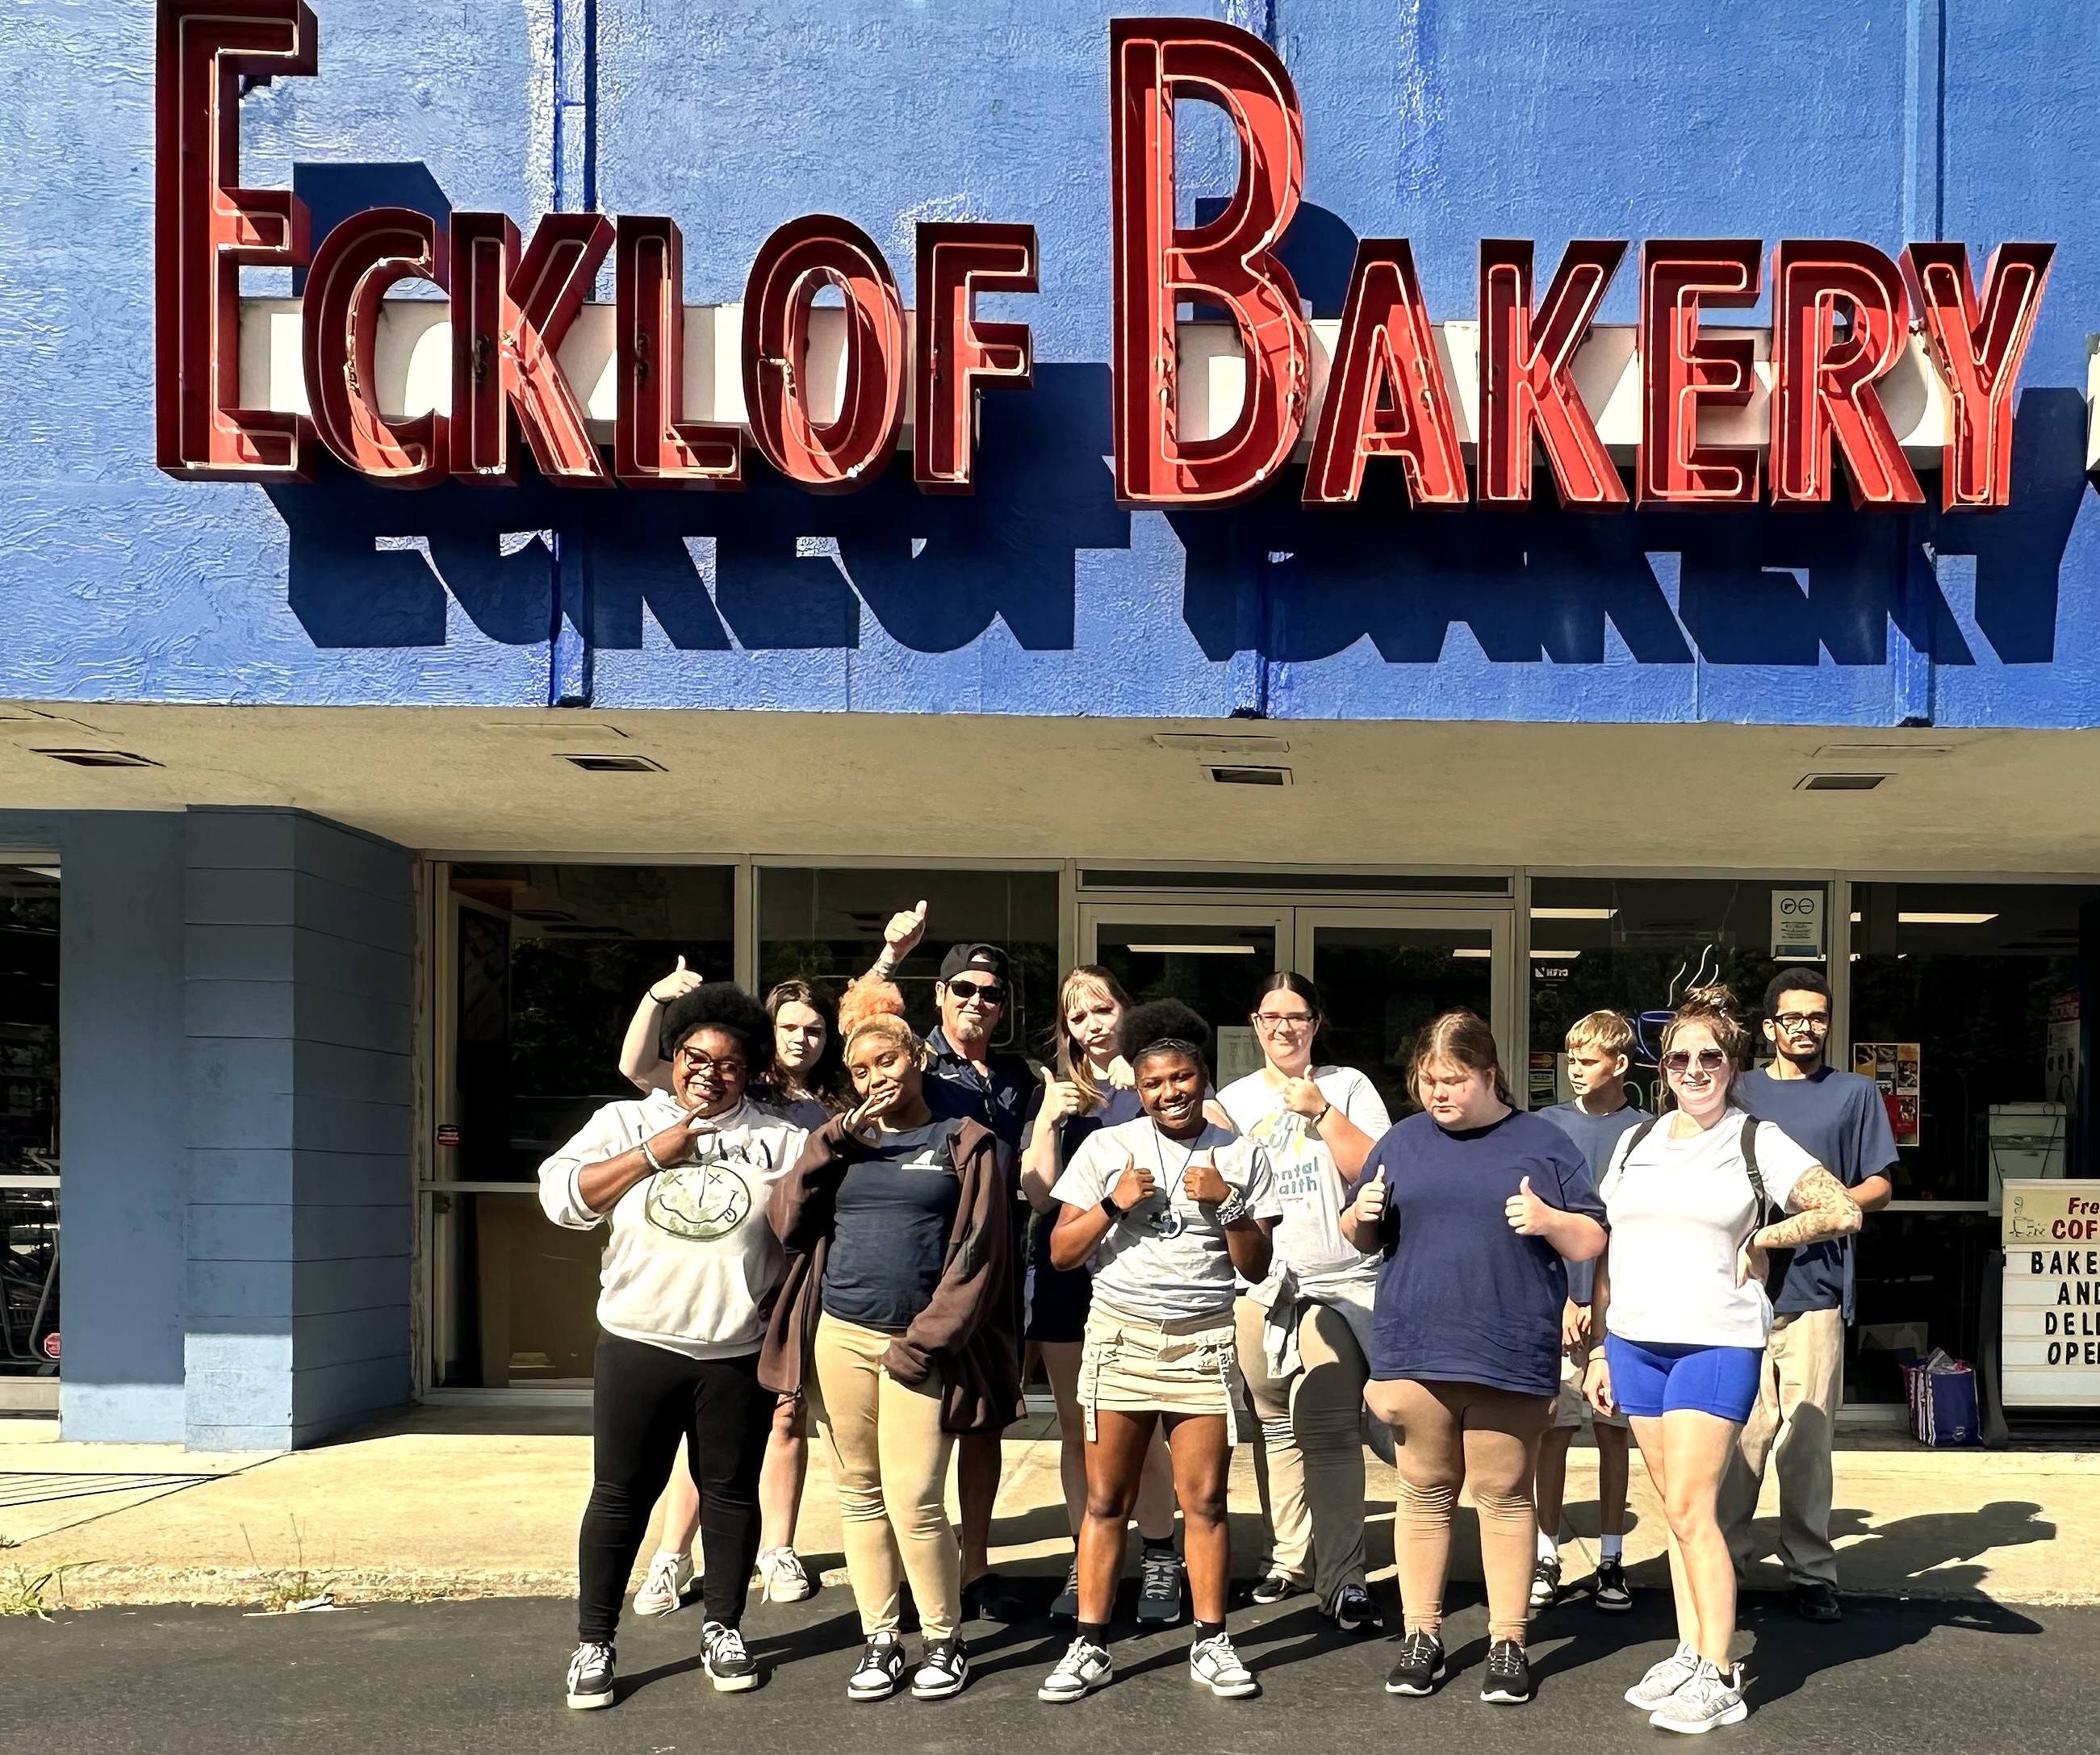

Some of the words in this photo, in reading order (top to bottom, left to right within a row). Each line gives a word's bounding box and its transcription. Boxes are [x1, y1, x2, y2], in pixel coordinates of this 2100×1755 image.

[156, 0, 1040, 492] ECKLOF
[1111, 18, 2056, 512] BAKERY
[2052, 1219, 2098, 1239] COF
[2031, 1251, 2098, 1274] BAKE
[2048, 1342, 2100, 1365] OPE
